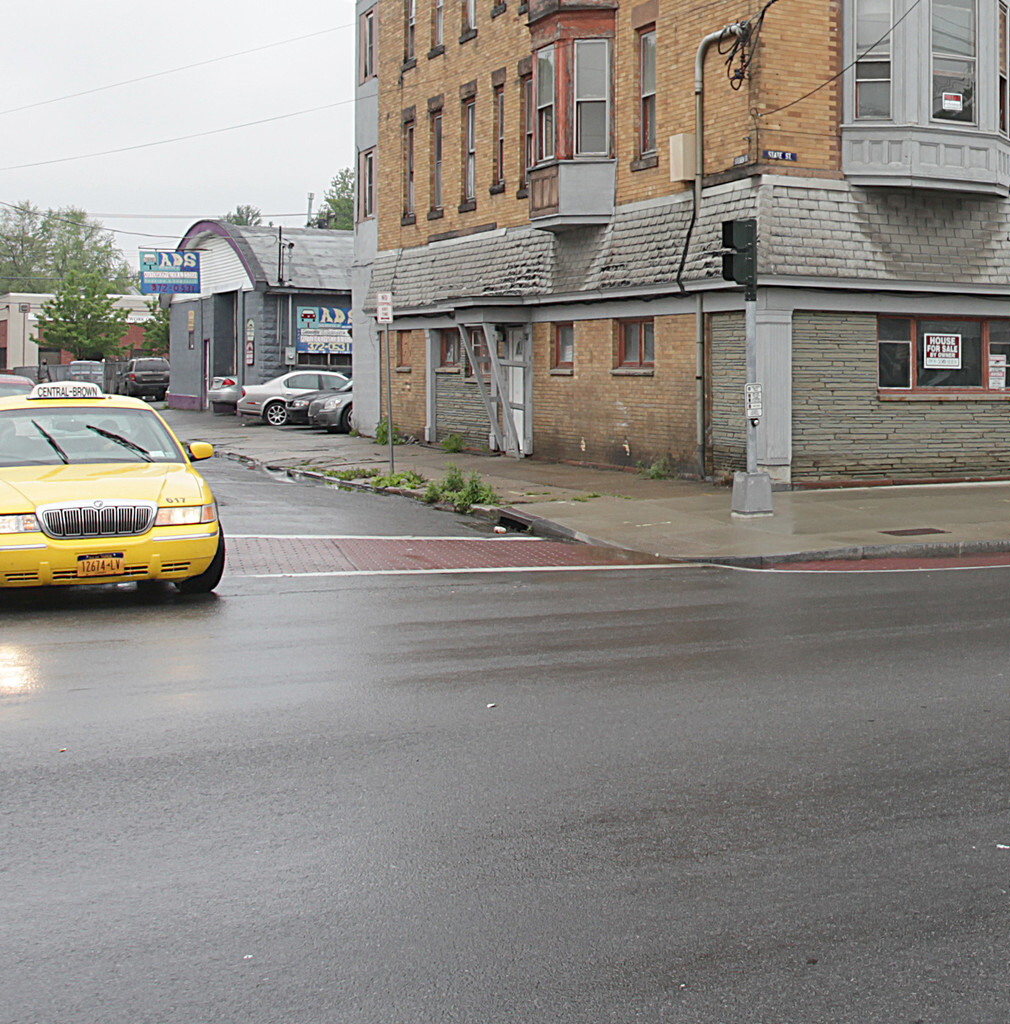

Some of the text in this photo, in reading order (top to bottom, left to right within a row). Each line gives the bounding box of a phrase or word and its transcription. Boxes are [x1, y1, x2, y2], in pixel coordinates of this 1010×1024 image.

[767, 150, 783, 160] STATE
[160, 252, 197, 268] ADS
[929, 337, 956, 345] HOUSE
[307, 342, 350, 352] 372-0531
[927, 345, 958, 353] FOR SALE
[37, 387, 98, 397] CENTRAL-BROWN
